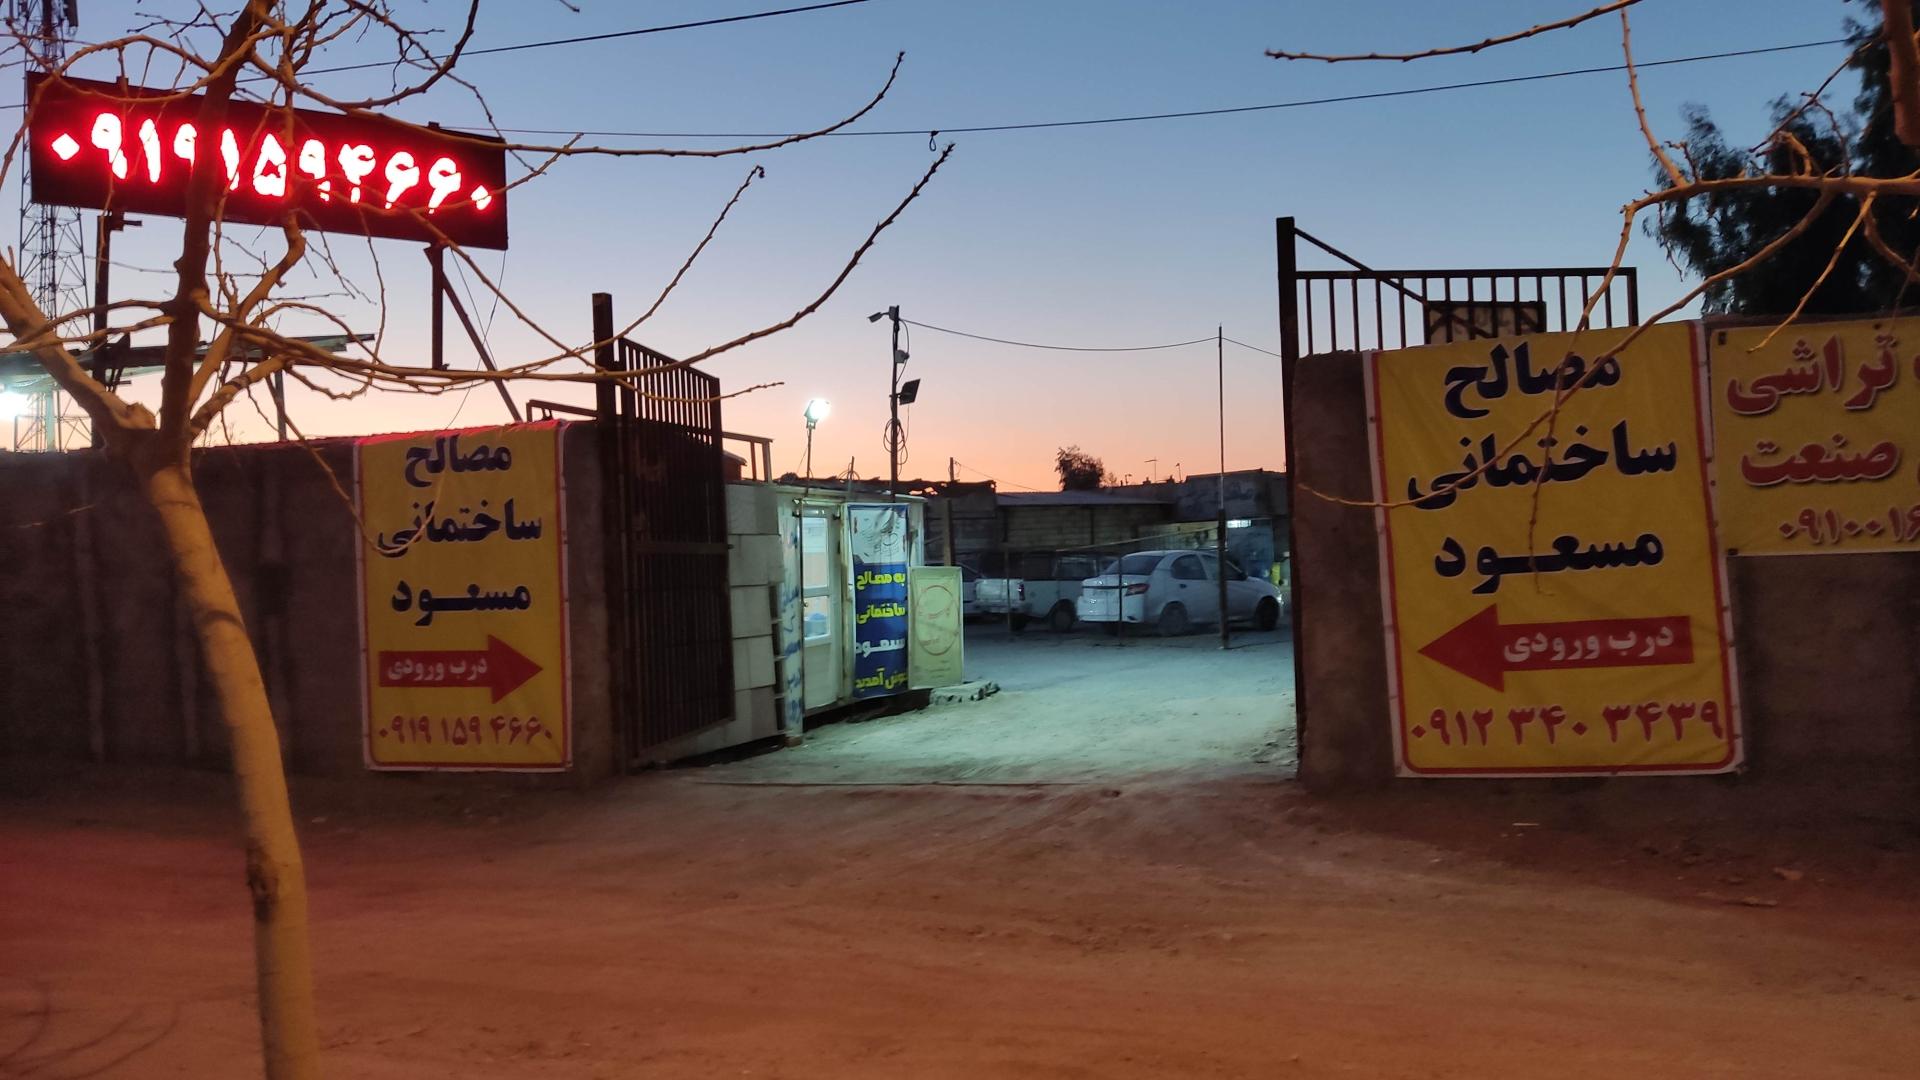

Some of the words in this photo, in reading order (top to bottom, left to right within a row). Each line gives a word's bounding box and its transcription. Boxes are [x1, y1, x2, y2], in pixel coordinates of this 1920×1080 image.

[1444, 341, 1622, 419] مصالح
[1727, 334, 1897, 415] تراشی
[405, 434, 512, 487] مصالح
[1407, 420, 1677, 510] ساختمانی
[1741, 433, 1900, 486] صنعت
[377, 497, 543, 558] ساختمانی
[856, 571, 892, 590] مصالح
[893, 573, 906, 587] به
[1434, 533, 1664, 595] مسعود
[391, 580, 533, 626] مسعود
[856, 602, 906, 625] ساختمانی
[855, 638, 906, 658] سعود
[1503, 632, 1600, 663] ورودی
[1608, 625, 1674, 657] درب
[387, 659, 445, 681] ورودی
[450, 661, 488, 681] درب
[379, 715, 432, 745] ۰۹۱۹
[441, 715, 482, 746] ۱۵۹
[489, 715, 553, 746] ۴۶۶۰
[1411, 705, 1495, 747] ۰۹۱۲
[1507, 703, 1589, 746] ۳۴۰
[1602, 699, 1726, 744] ۳۴۳۹
